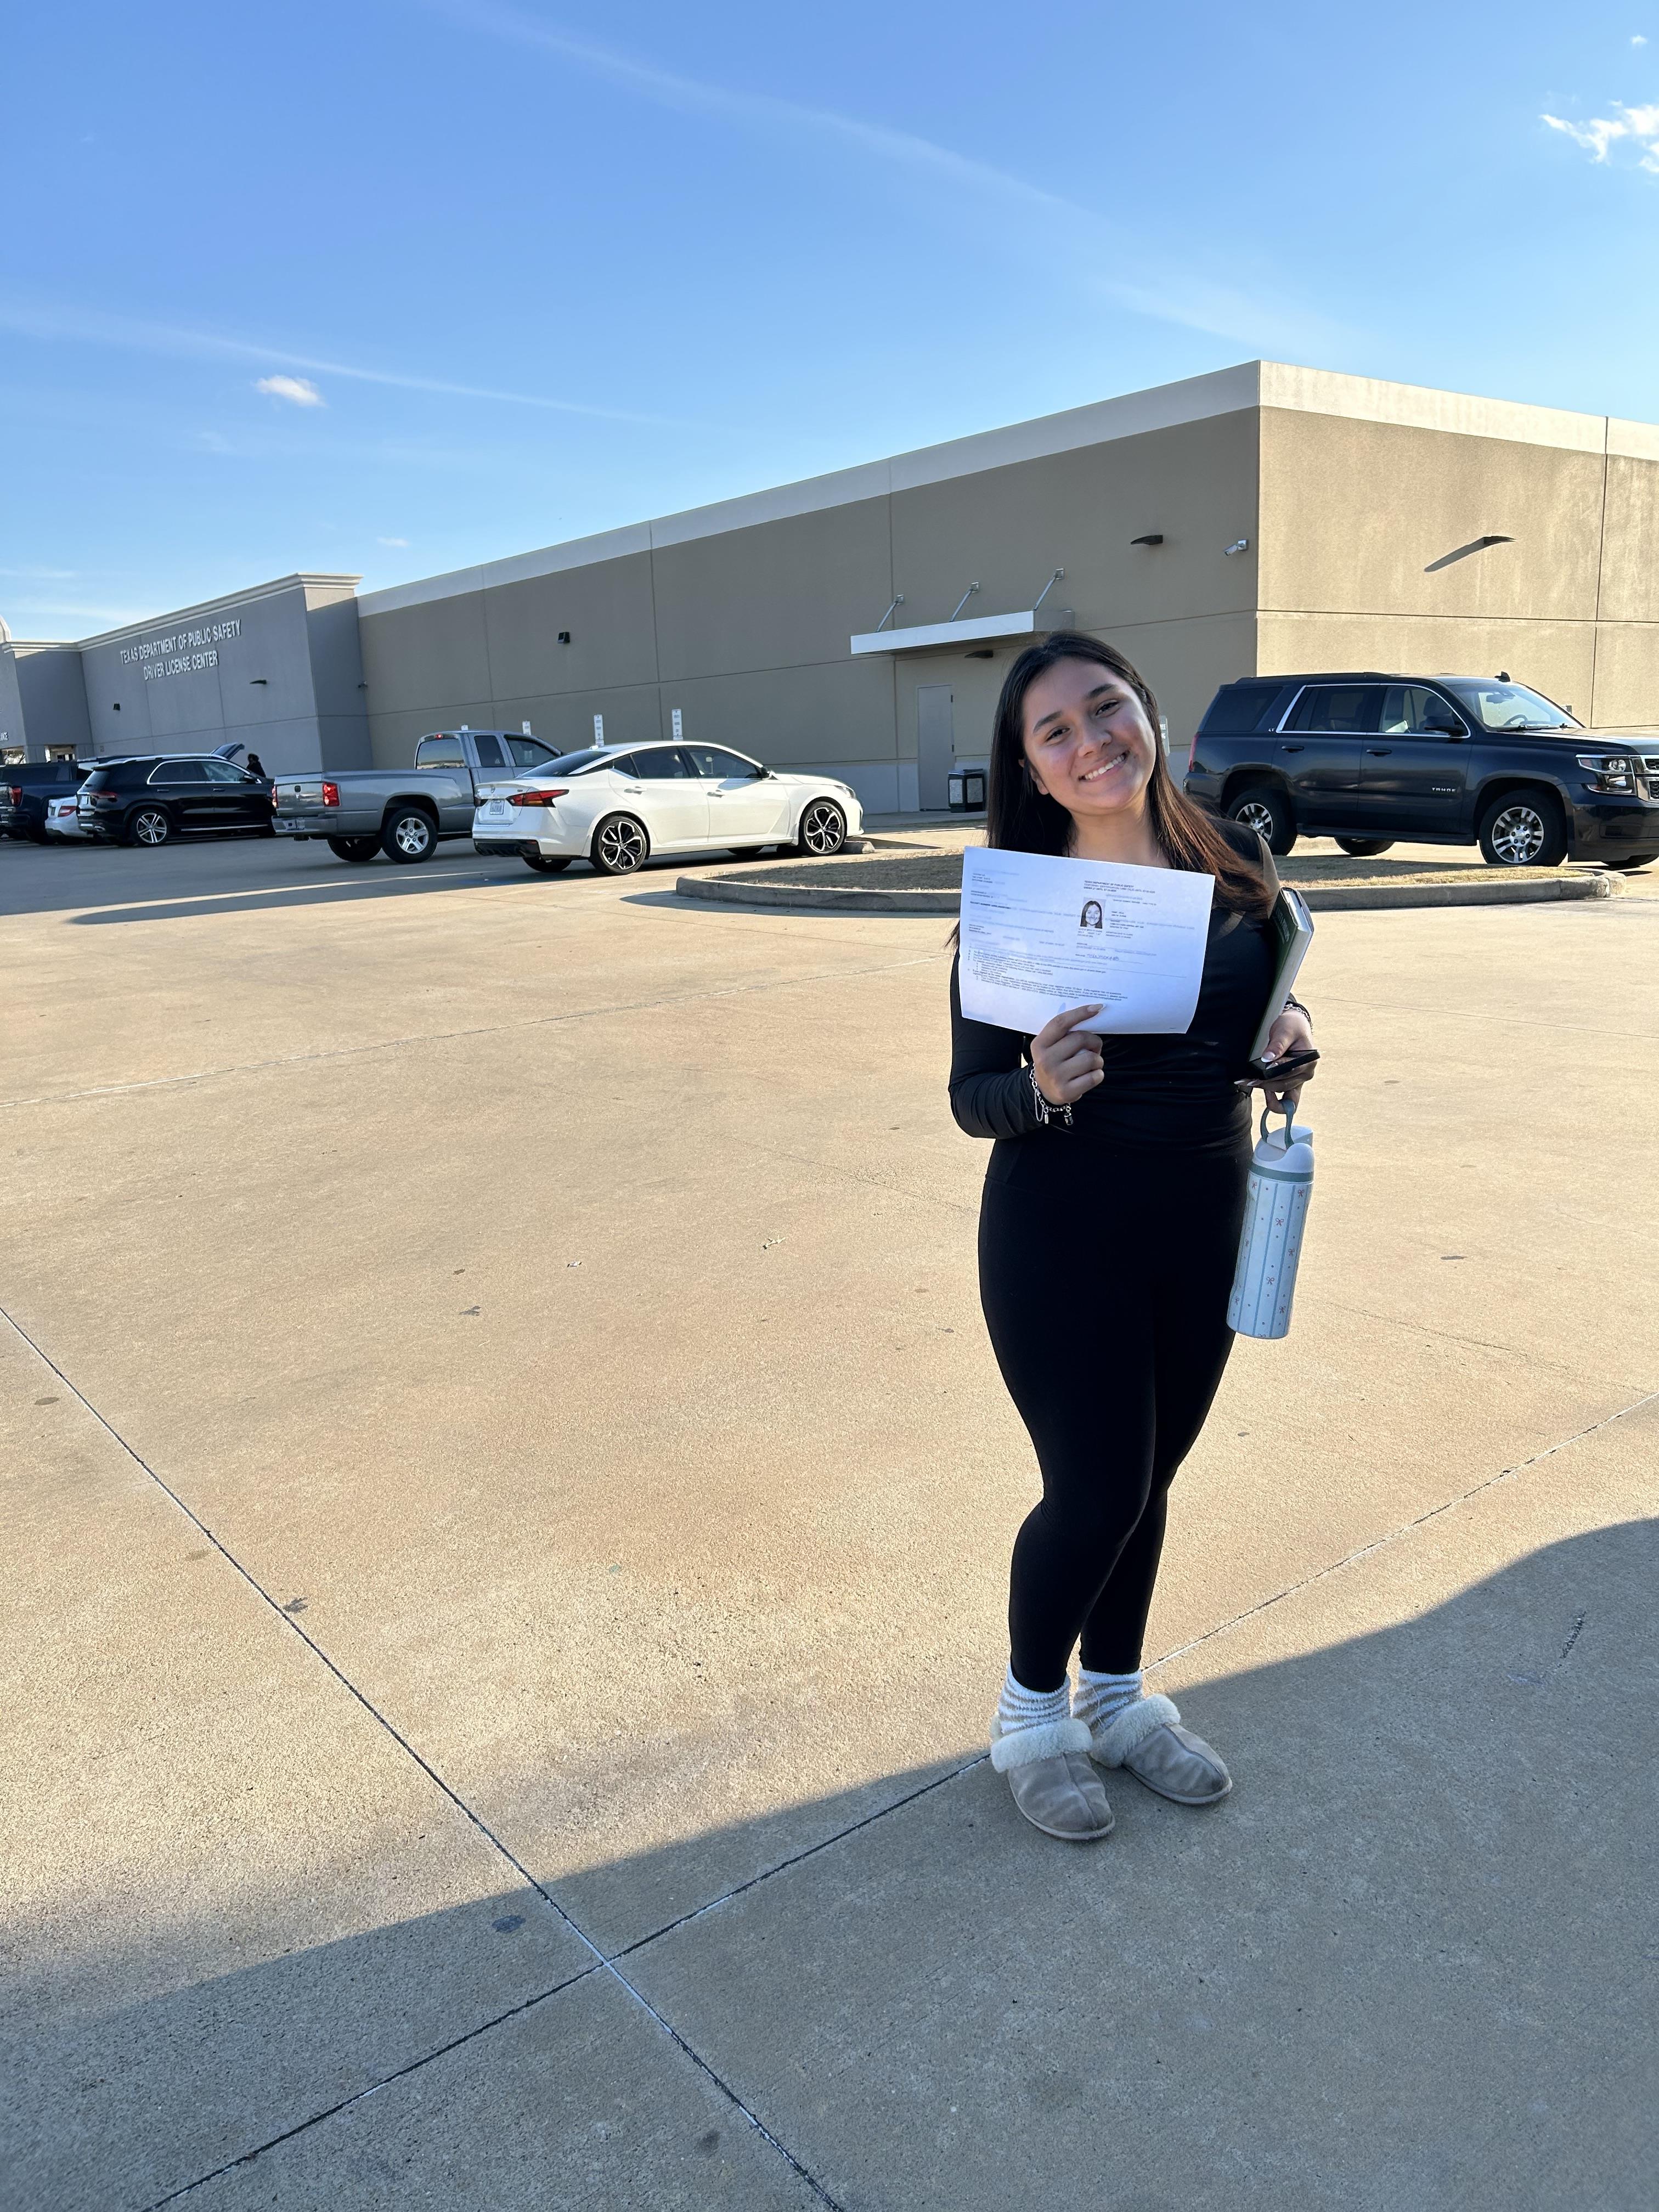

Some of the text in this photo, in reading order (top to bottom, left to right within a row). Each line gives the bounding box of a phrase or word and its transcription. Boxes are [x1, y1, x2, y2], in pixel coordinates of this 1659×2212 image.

[120, 619, 241, 664] TEXAS DEPARTMENT OF PUBLIC SAFETY
[143, 650, 218, 680] DRIVER LICENSE CENTER
